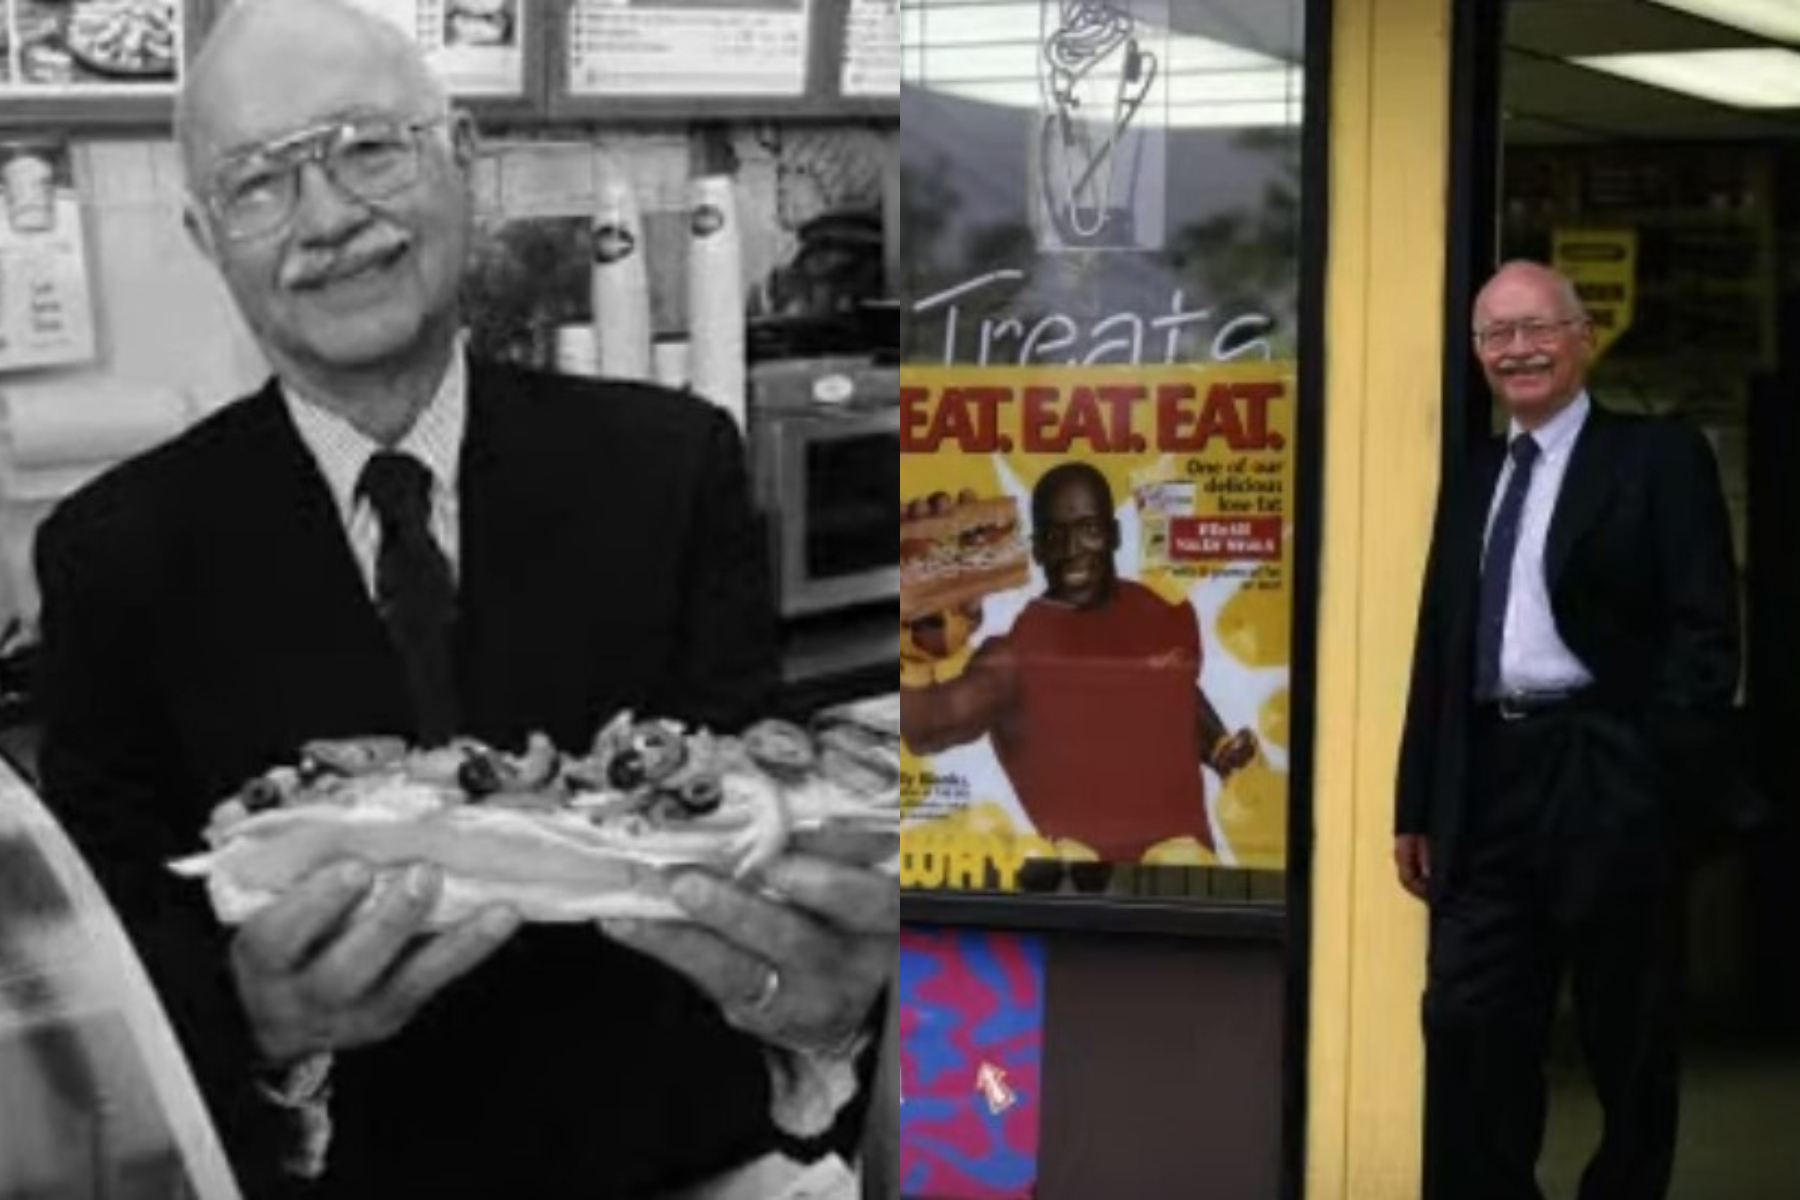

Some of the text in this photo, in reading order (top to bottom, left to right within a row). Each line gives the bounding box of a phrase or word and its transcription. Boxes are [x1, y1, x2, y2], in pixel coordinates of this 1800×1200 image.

[913, 268, 1272, 366] Treats
[900, 383, 1285, 453] EAT. EAT. EAT.
